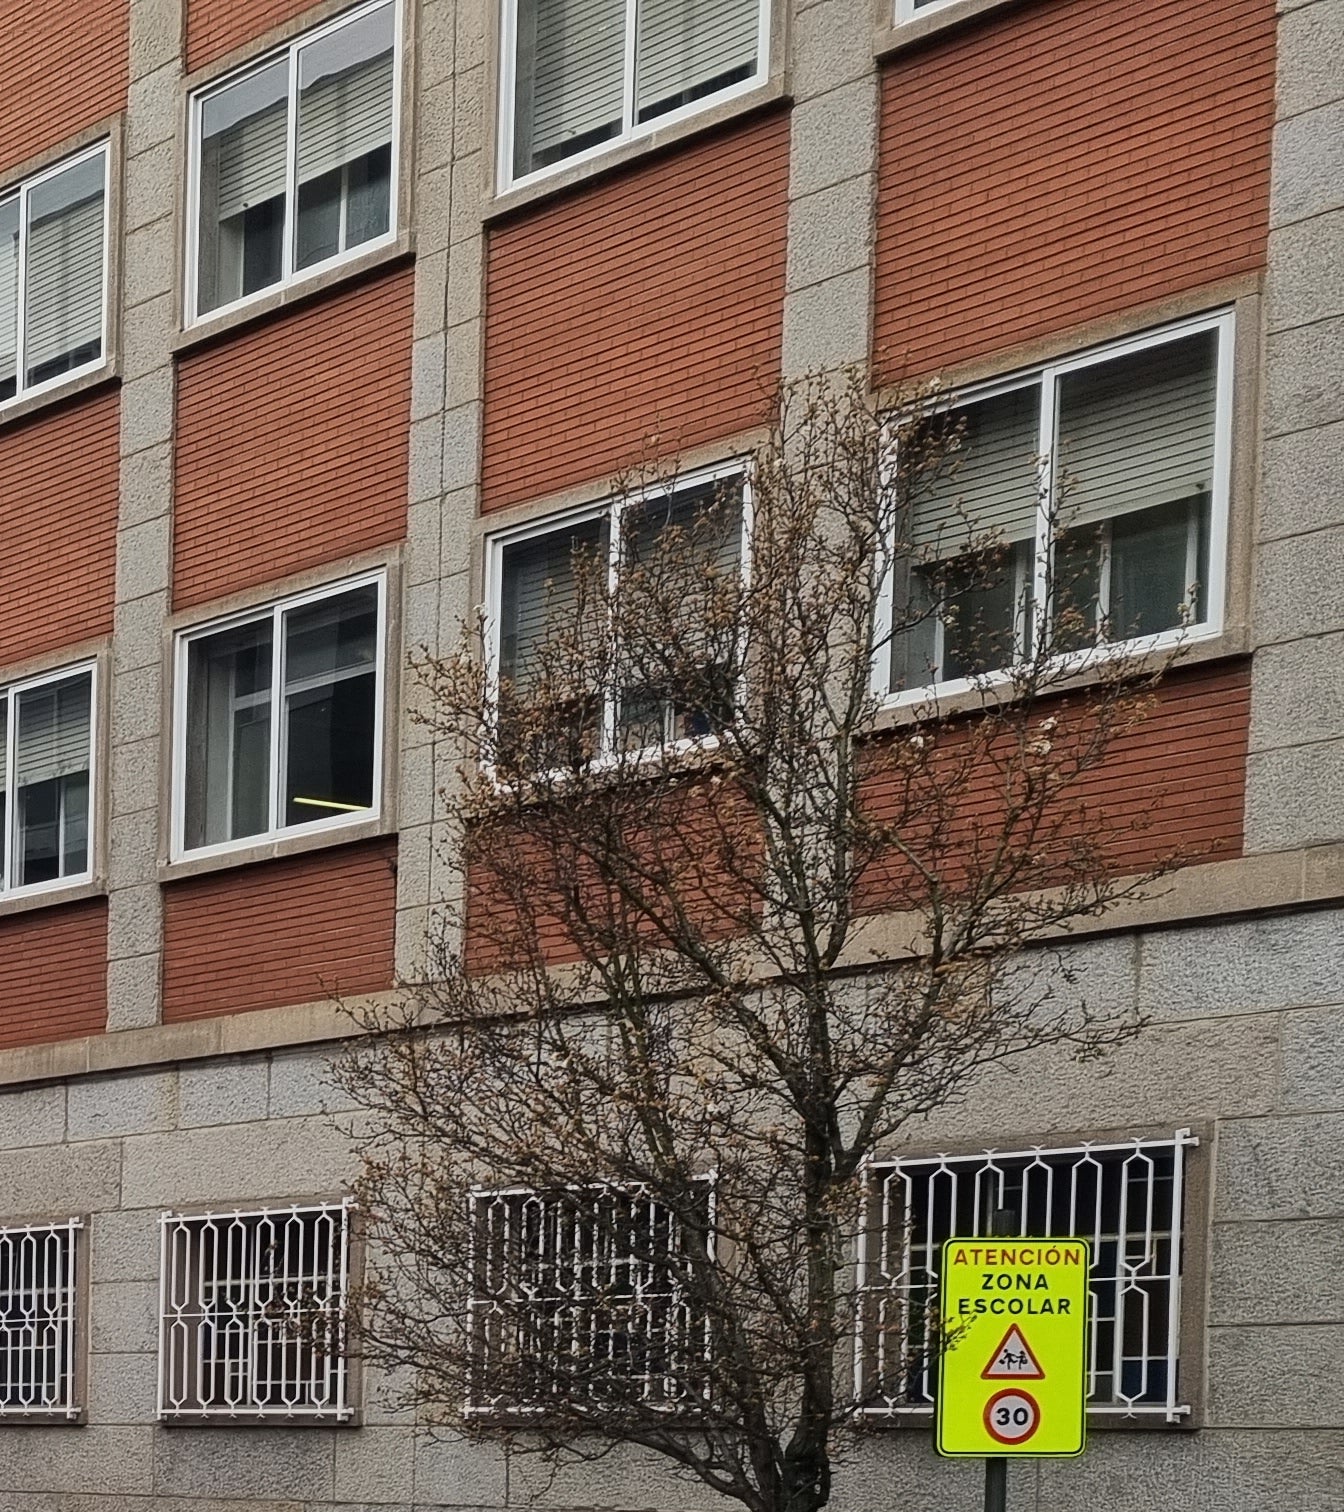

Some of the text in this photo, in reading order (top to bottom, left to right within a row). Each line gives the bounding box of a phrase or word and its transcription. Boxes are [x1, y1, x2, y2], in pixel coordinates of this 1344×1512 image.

[953, 1245, 1080, 1266] ATENCIÓN
[981, 1273, 1049, 1291] ZONA
[958, 1298, 1072, 1315] ESCOLAR
[996, 1407, 1029, 1426] 30
